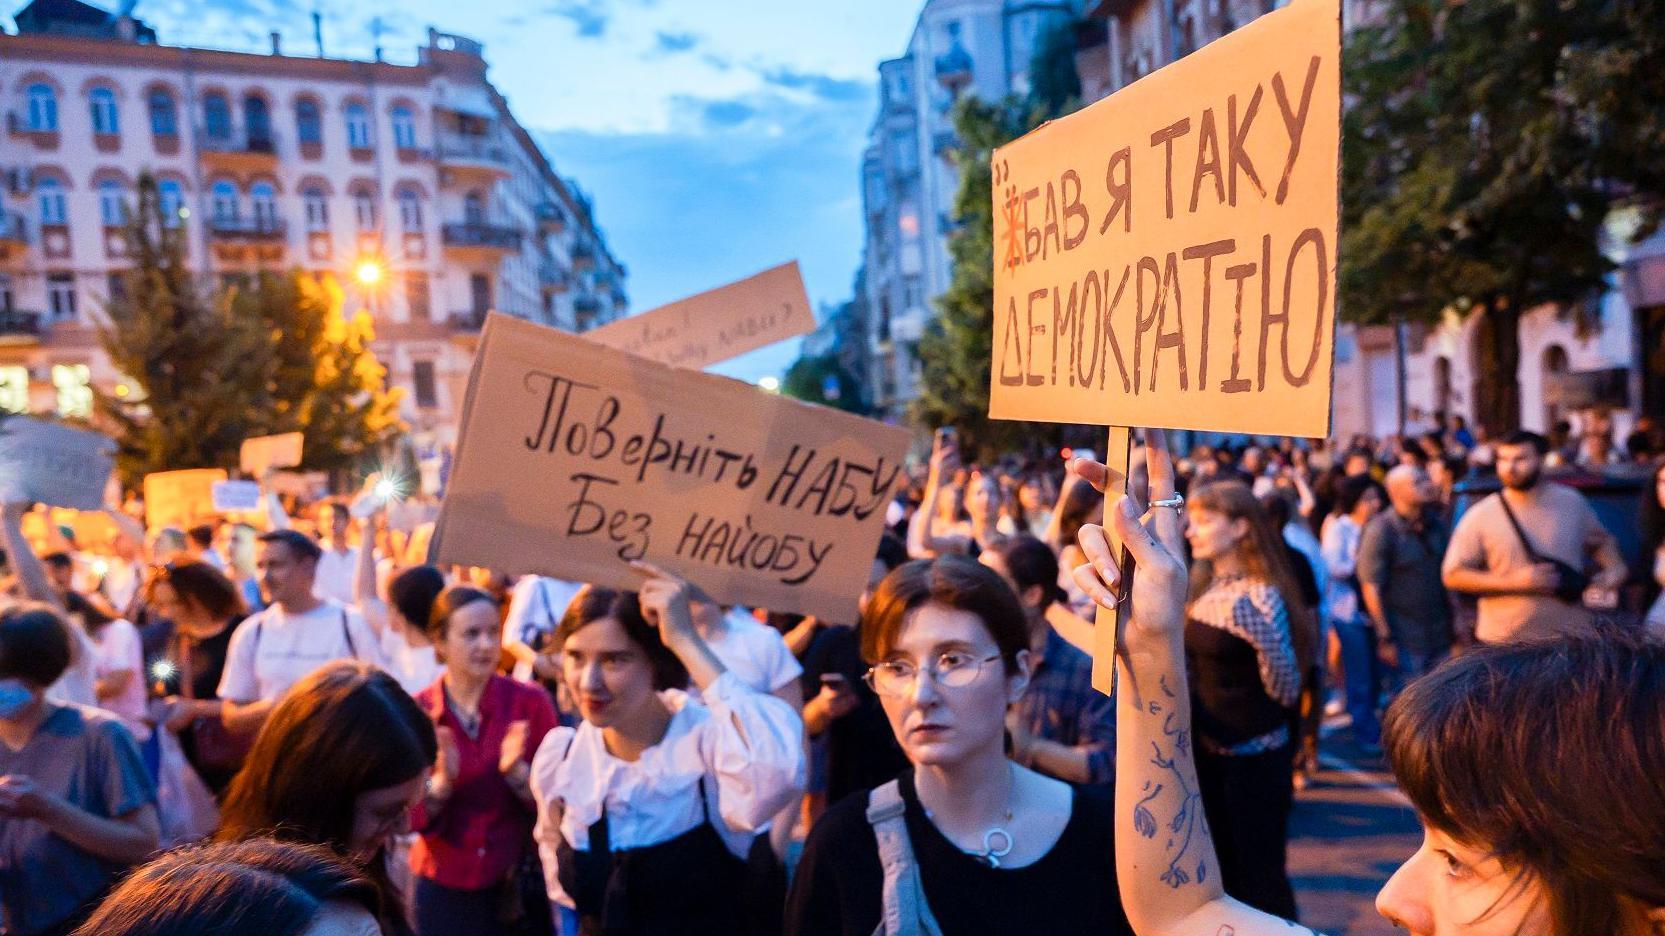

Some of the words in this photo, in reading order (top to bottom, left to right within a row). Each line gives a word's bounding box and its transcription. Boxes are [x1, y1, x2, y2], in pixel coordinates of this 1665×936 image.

[1099, 146, 1131, 236] Я
[1150, 55, 1321, 219] ТАКУ
[999, 227, 1327, 396] ДЕМОКРАТІЮ
[567, 472, 653, 562] Без
[765, 444, 900, 522] НАБУ
